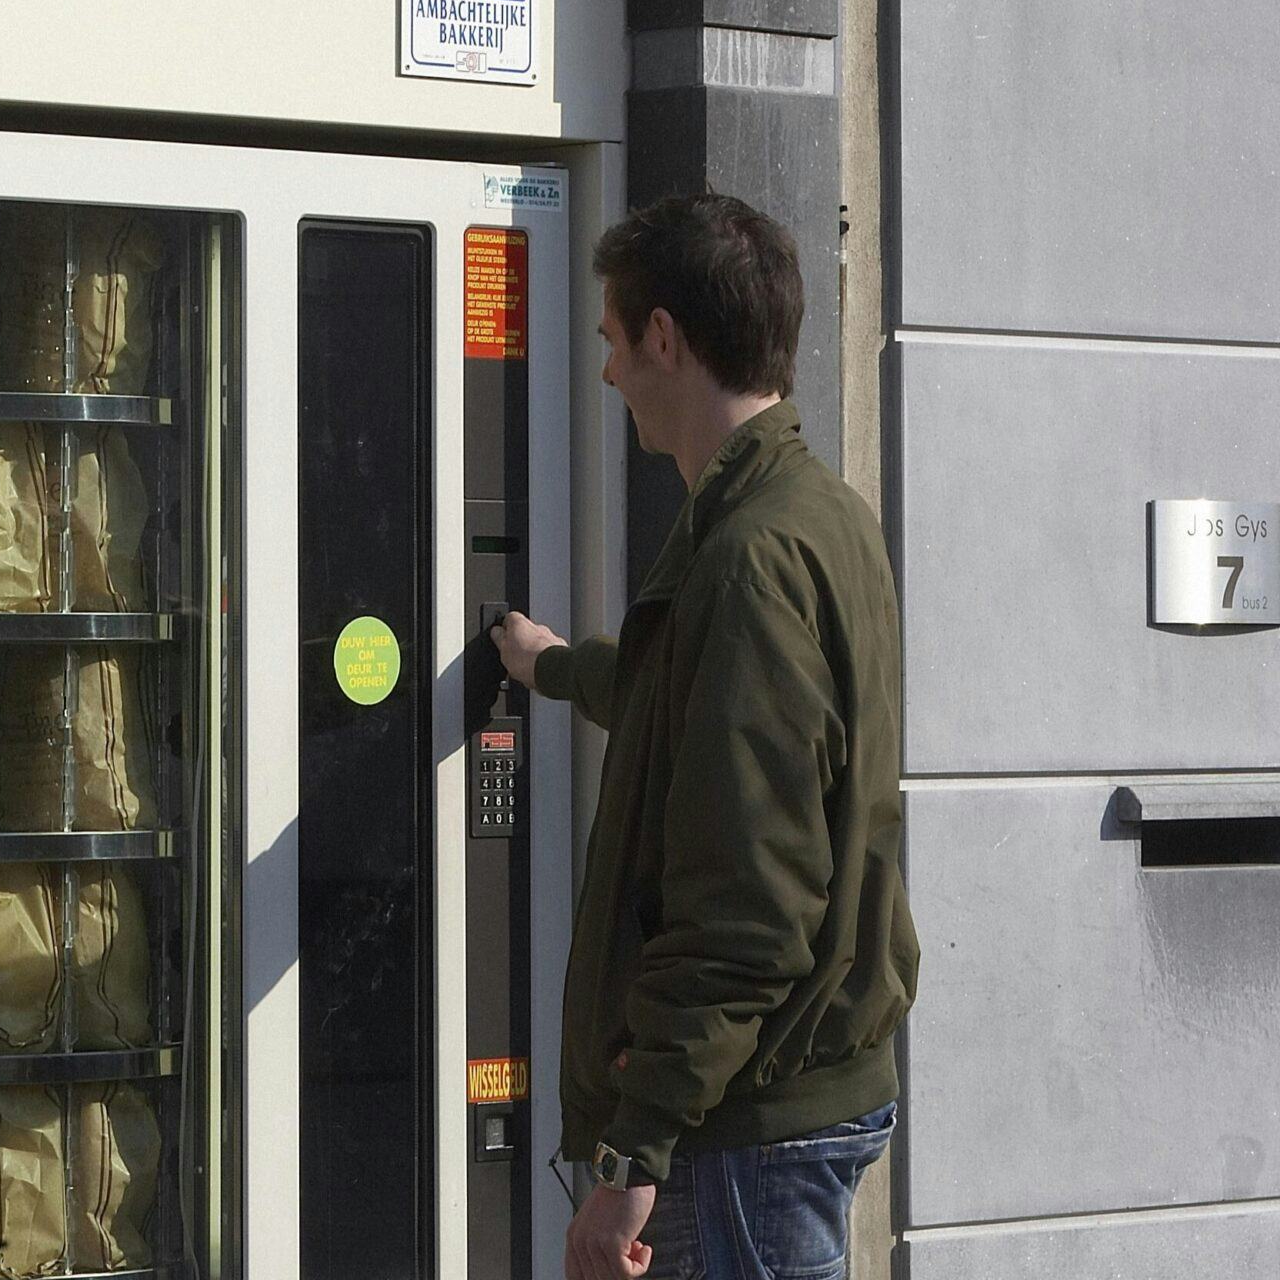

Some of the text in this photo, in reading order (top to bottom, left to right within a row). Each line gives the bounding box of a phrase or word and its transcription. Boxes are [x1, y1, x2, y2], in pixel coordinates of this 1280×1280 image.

[439, 22, 504, 54] BAKKERIJ
[500, 185, 539, 198] VERBEEK
[548, 187, 560, 199] Zn
[1235, 514, 1268, 543] Gys
[1217, 556, 1269, 610] 7 bus 2
[341, 635, 391, 648] DUW HIER
[359, 649, 375, 660] OM
[347, 662, 388, 675] DEUR TE
[350, 676, 387, 688] OPENEN
[496, 761, 501, 771] 2
[509, 760, 514, 771] 3
[483, 779, 514, 788] 4 5 6
[483, 796, 514, 806] 7 8 9
[482, 814, 489, 824] A
[469, 1062, 527, 1099] WISSELGELD
